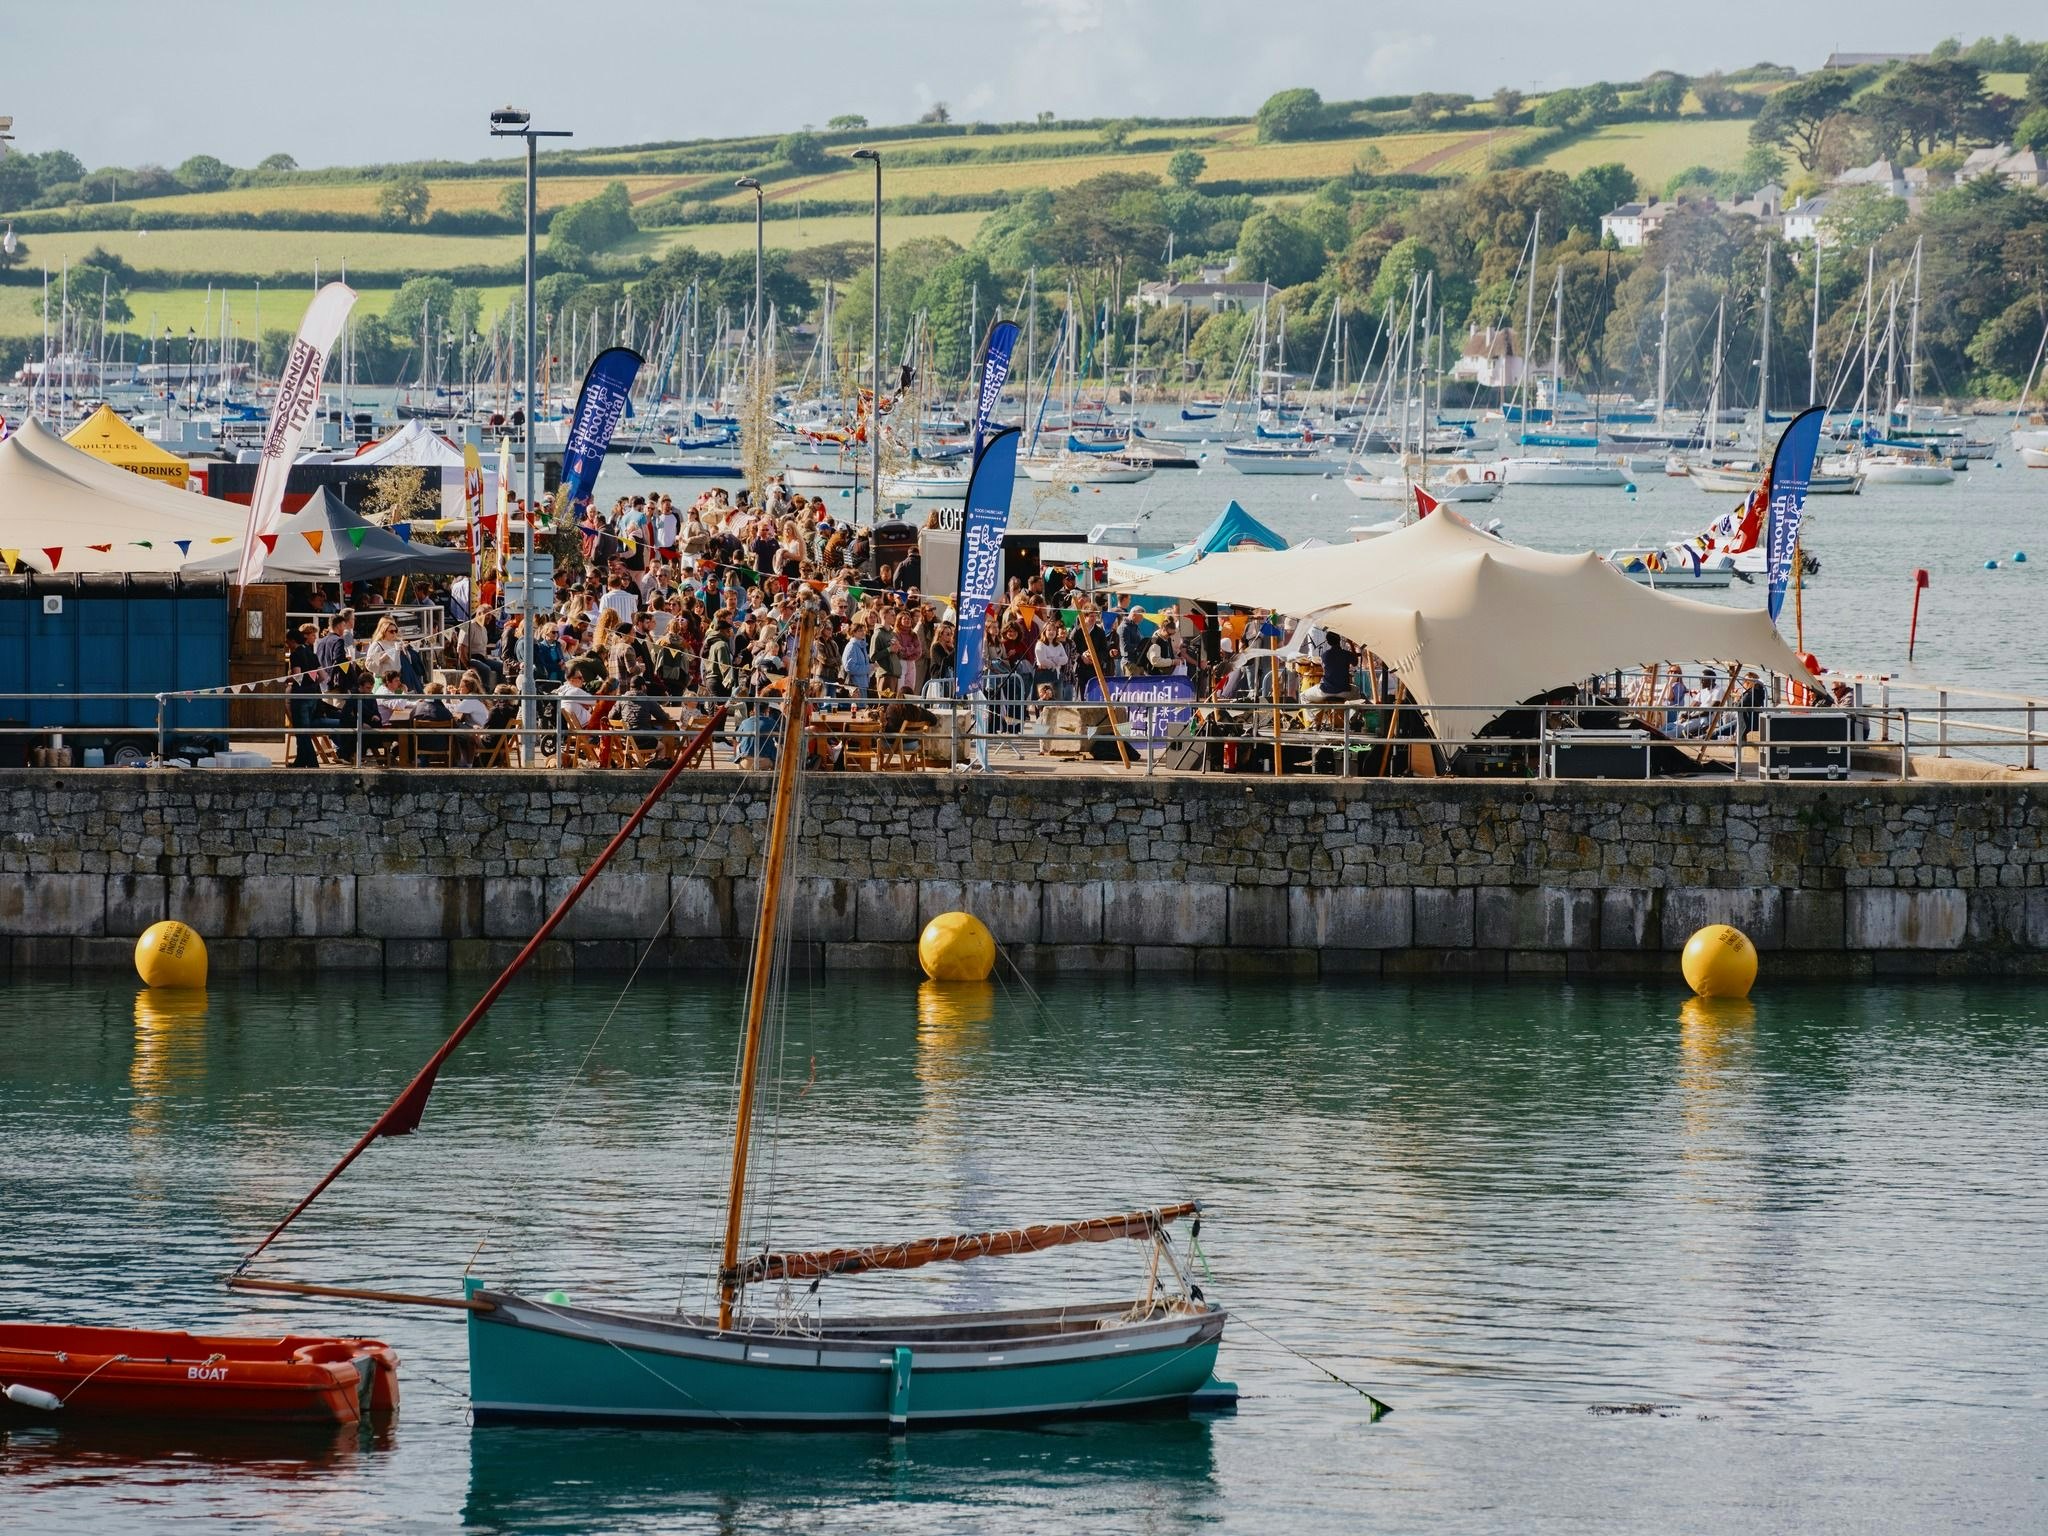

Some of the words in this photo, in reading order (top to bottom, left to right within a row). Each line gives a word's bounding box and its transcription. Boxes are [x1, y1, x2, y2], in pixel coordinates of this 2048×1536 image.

[278, 338, 310, 412] CORNISH
[288, 350, 324, 432] ITALIAN
[568, 384, 601, 455] Falmouth
[585, 405, 607, 444] Food
[594, 392, 625, 449] Festival
[141, 465, 182, 477] DRINKS
[981, 526, 1005, 601] Festival
[1768, 495, 1787, 584] Falmouth
[1781, 518, 1799, 565] Food
[959, 525, 982, 620] Falmouth
[970, 550, 990, 600] Food
[188, 1367, 229, 1380] BOAT
